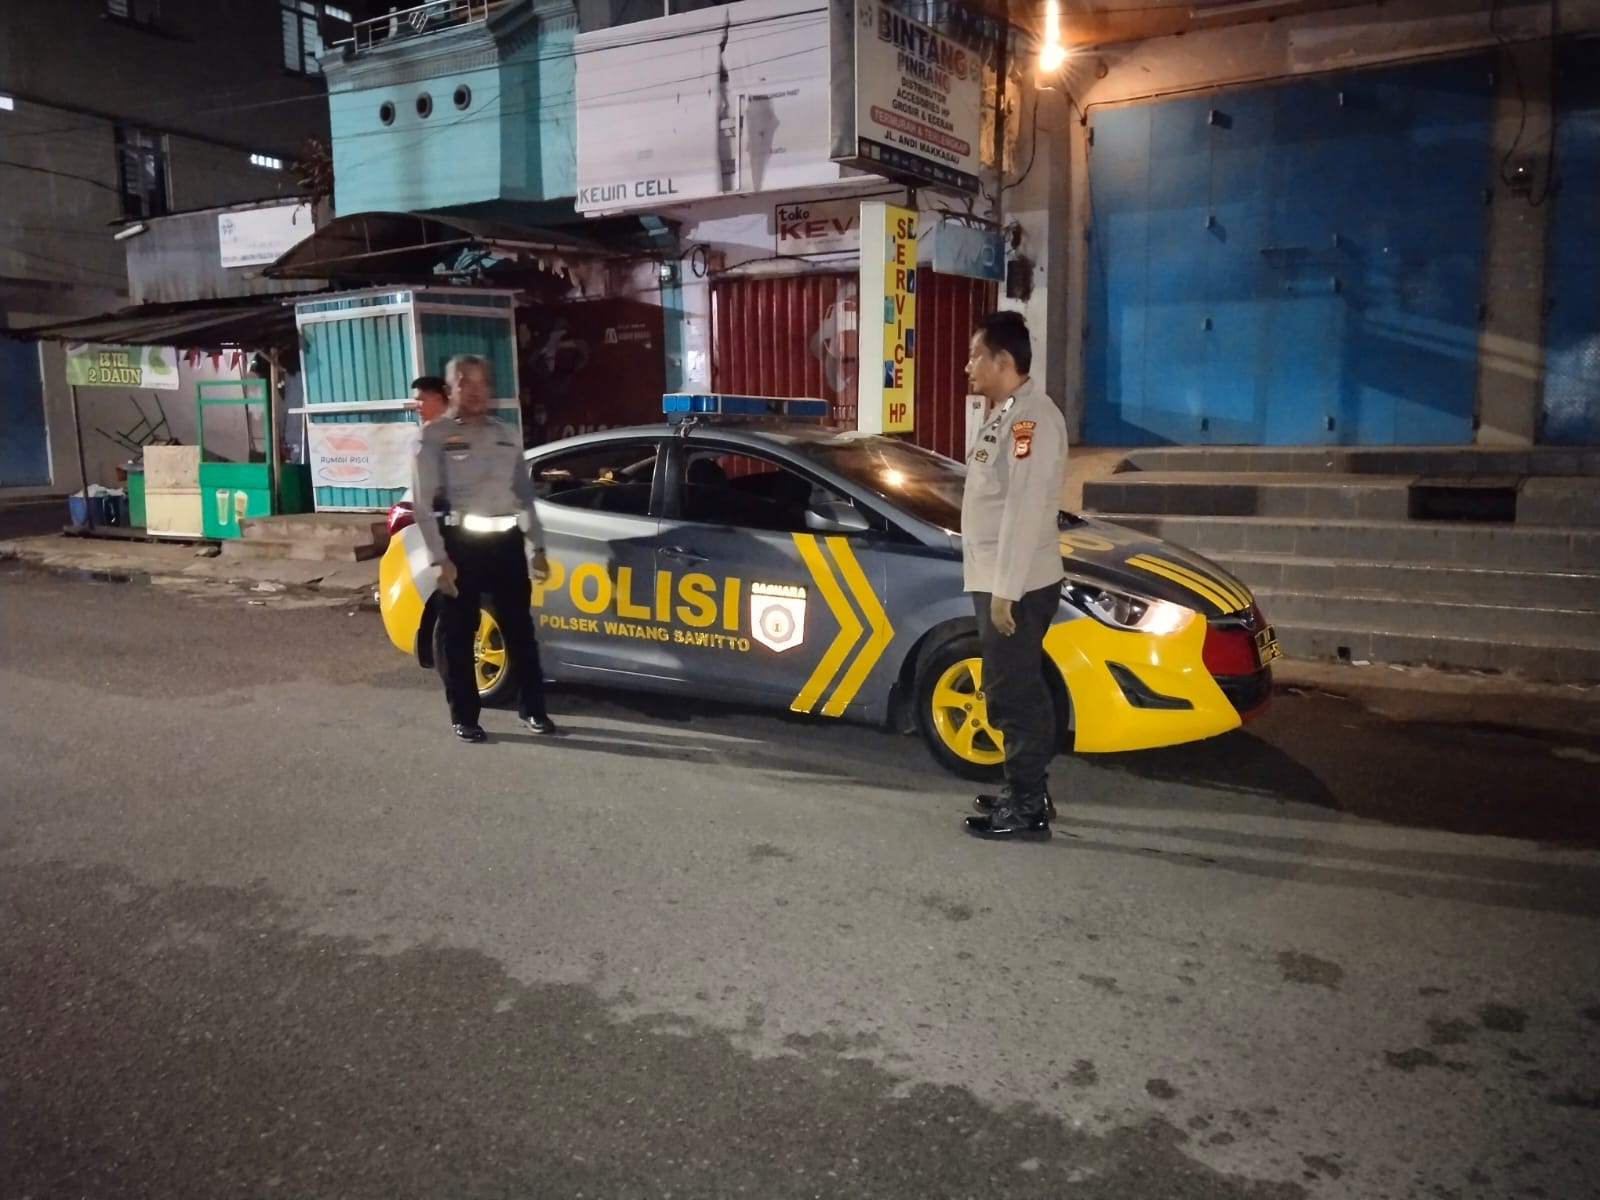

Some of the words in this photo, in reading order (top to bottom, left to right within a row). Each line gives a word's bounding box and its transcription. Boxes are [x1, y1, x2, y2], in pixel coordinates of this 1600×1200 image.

[878, 7, 968, 80] BINTANG
[897, 51, 951, 94] PINRANG
[899, 136, 918, 150] ANDI
[920, 143, 960, 164] MAKKASAU
[634, 178, 679, 199] CELL
[779, 206, 810, 220] toko
[894, 218, 907, 389] SERVICE
[88, 368, 97, 383] 2
[100, 367, 142, 384] DAUN
[889, 403, 907, 424] HP
[530, 558, 740, 631] POLISI
[539, 613, 599, 633] POLSEK
[604, 620, 670, 642] WATANG
